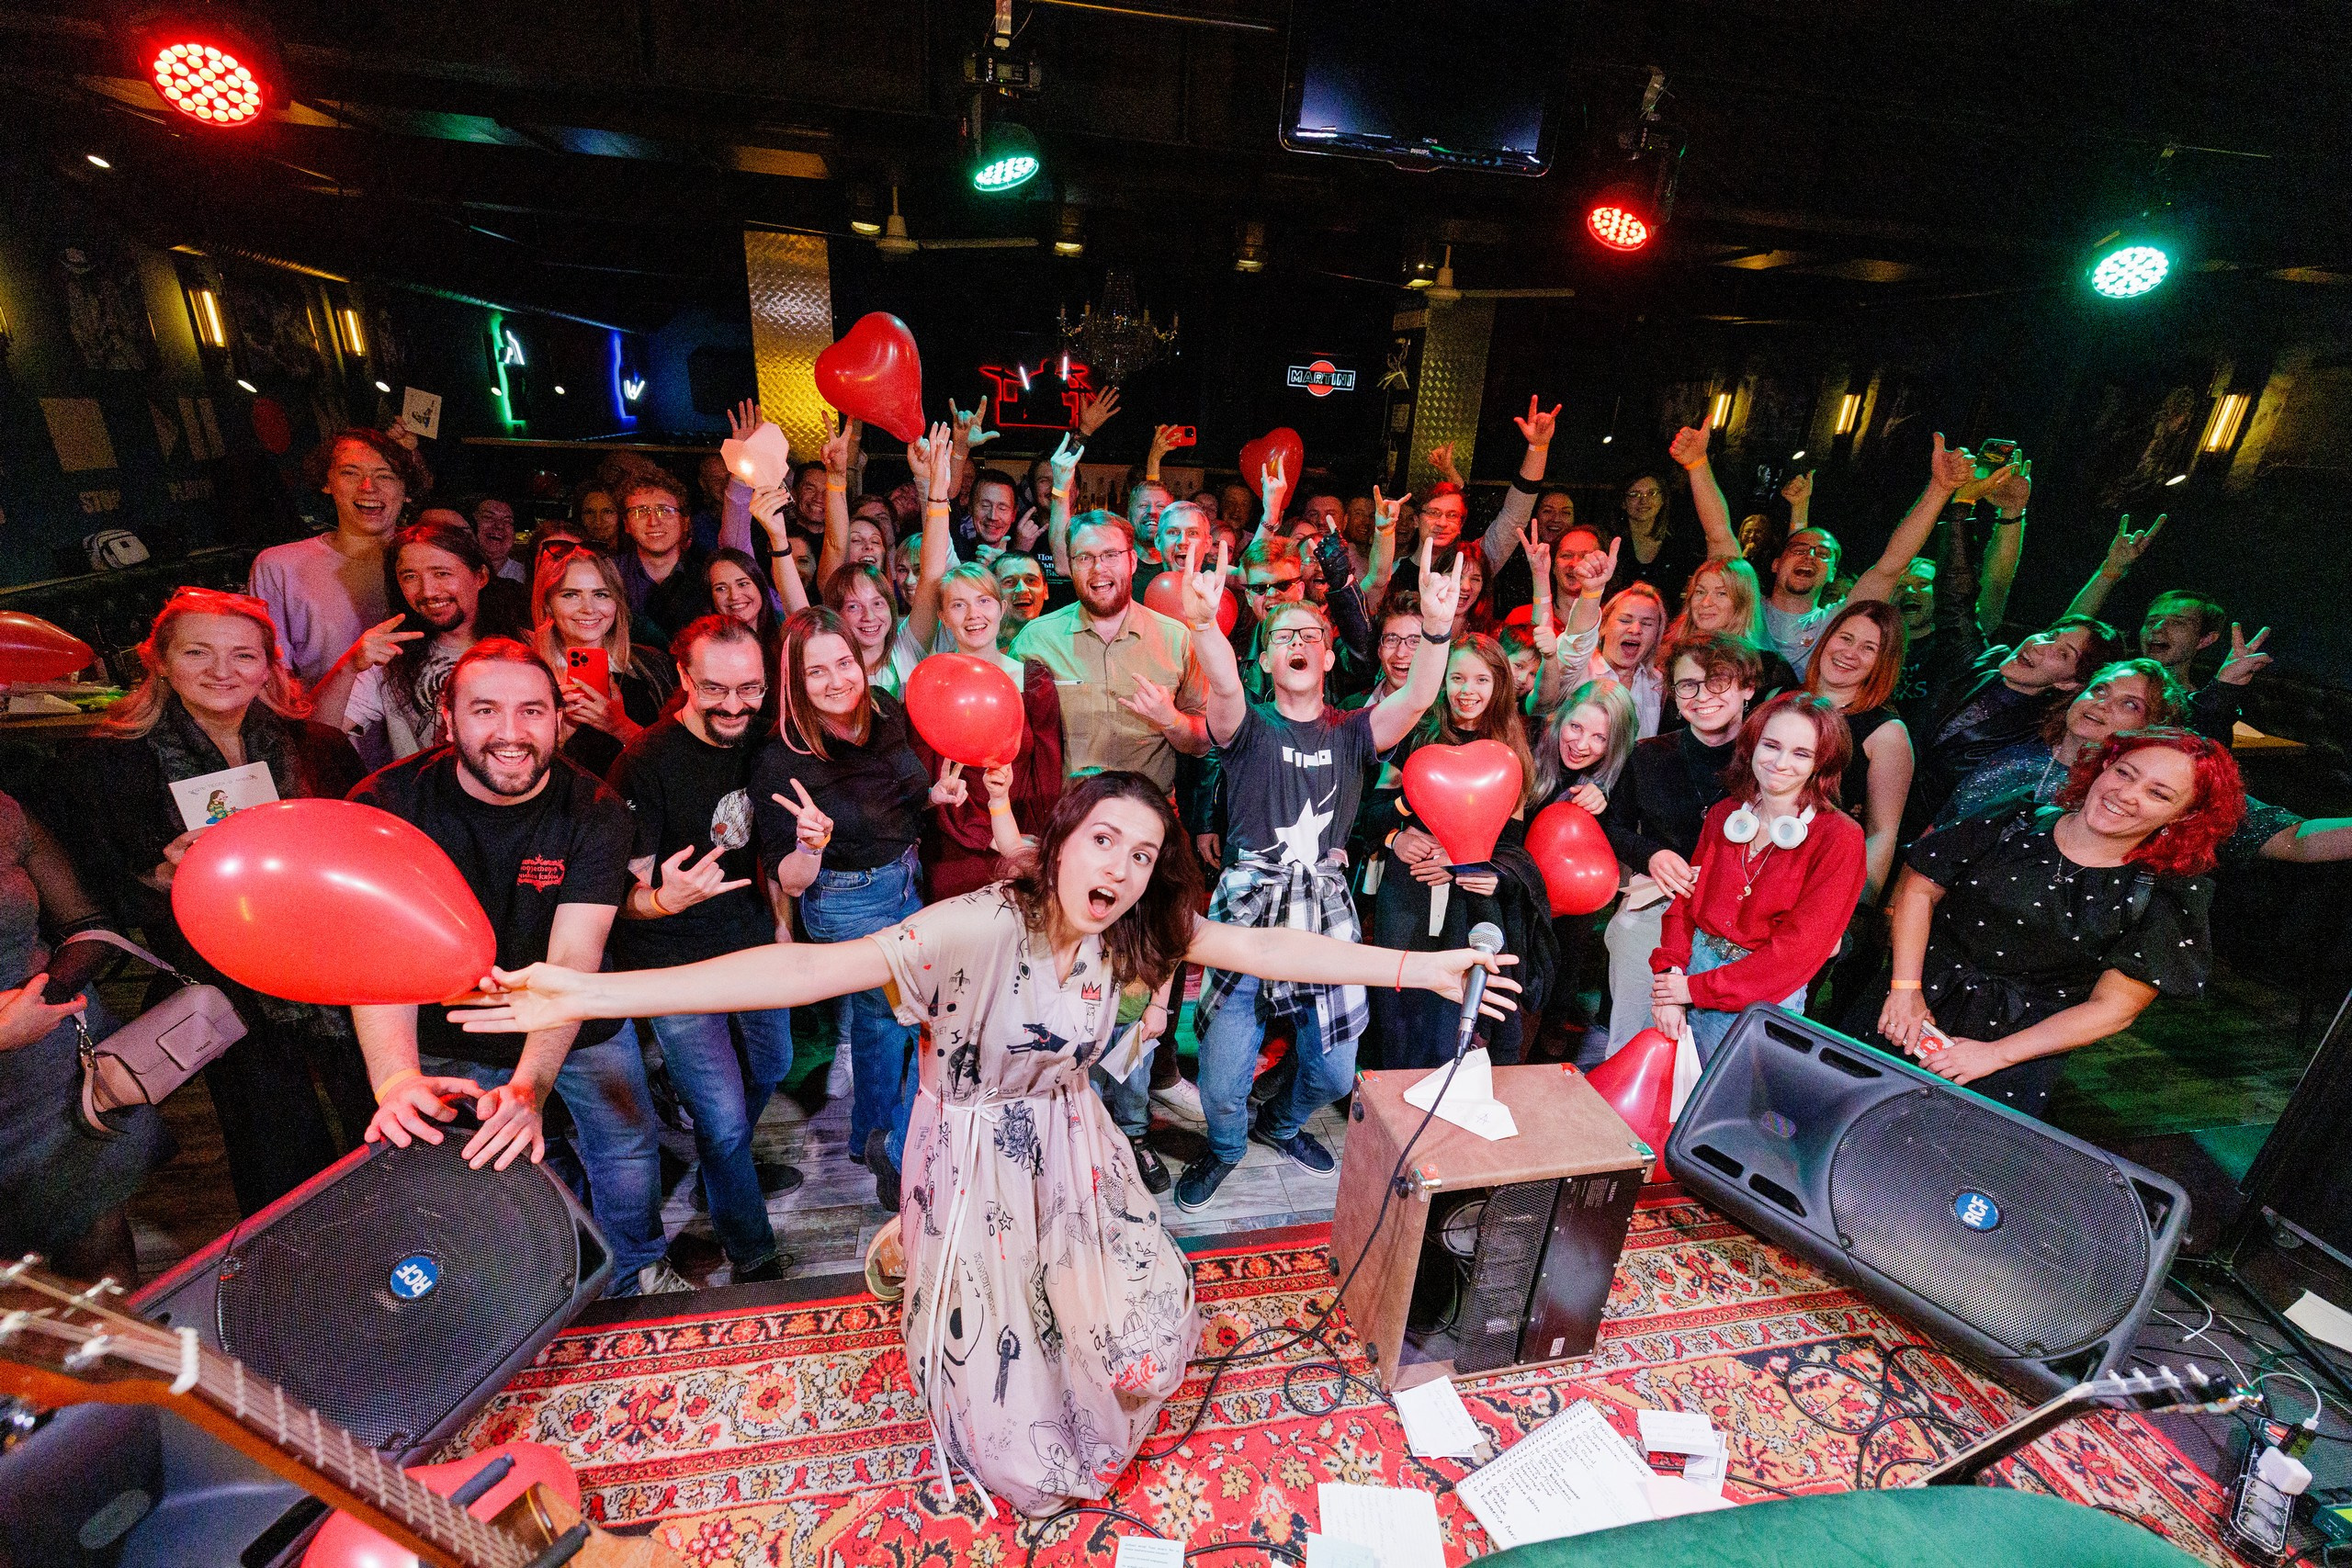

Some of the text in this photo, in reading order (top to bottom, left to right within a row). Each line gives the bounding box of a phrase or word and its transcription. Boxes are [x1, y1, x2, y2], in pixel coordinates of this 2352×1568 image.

[1410, 148, 1430, 156] PHILIPS
[1290, 369, 1353, 387] MARTINI
[1962, 1195, 1989, 1227] RCF
[395, 1264, 434, 1296] RCF
